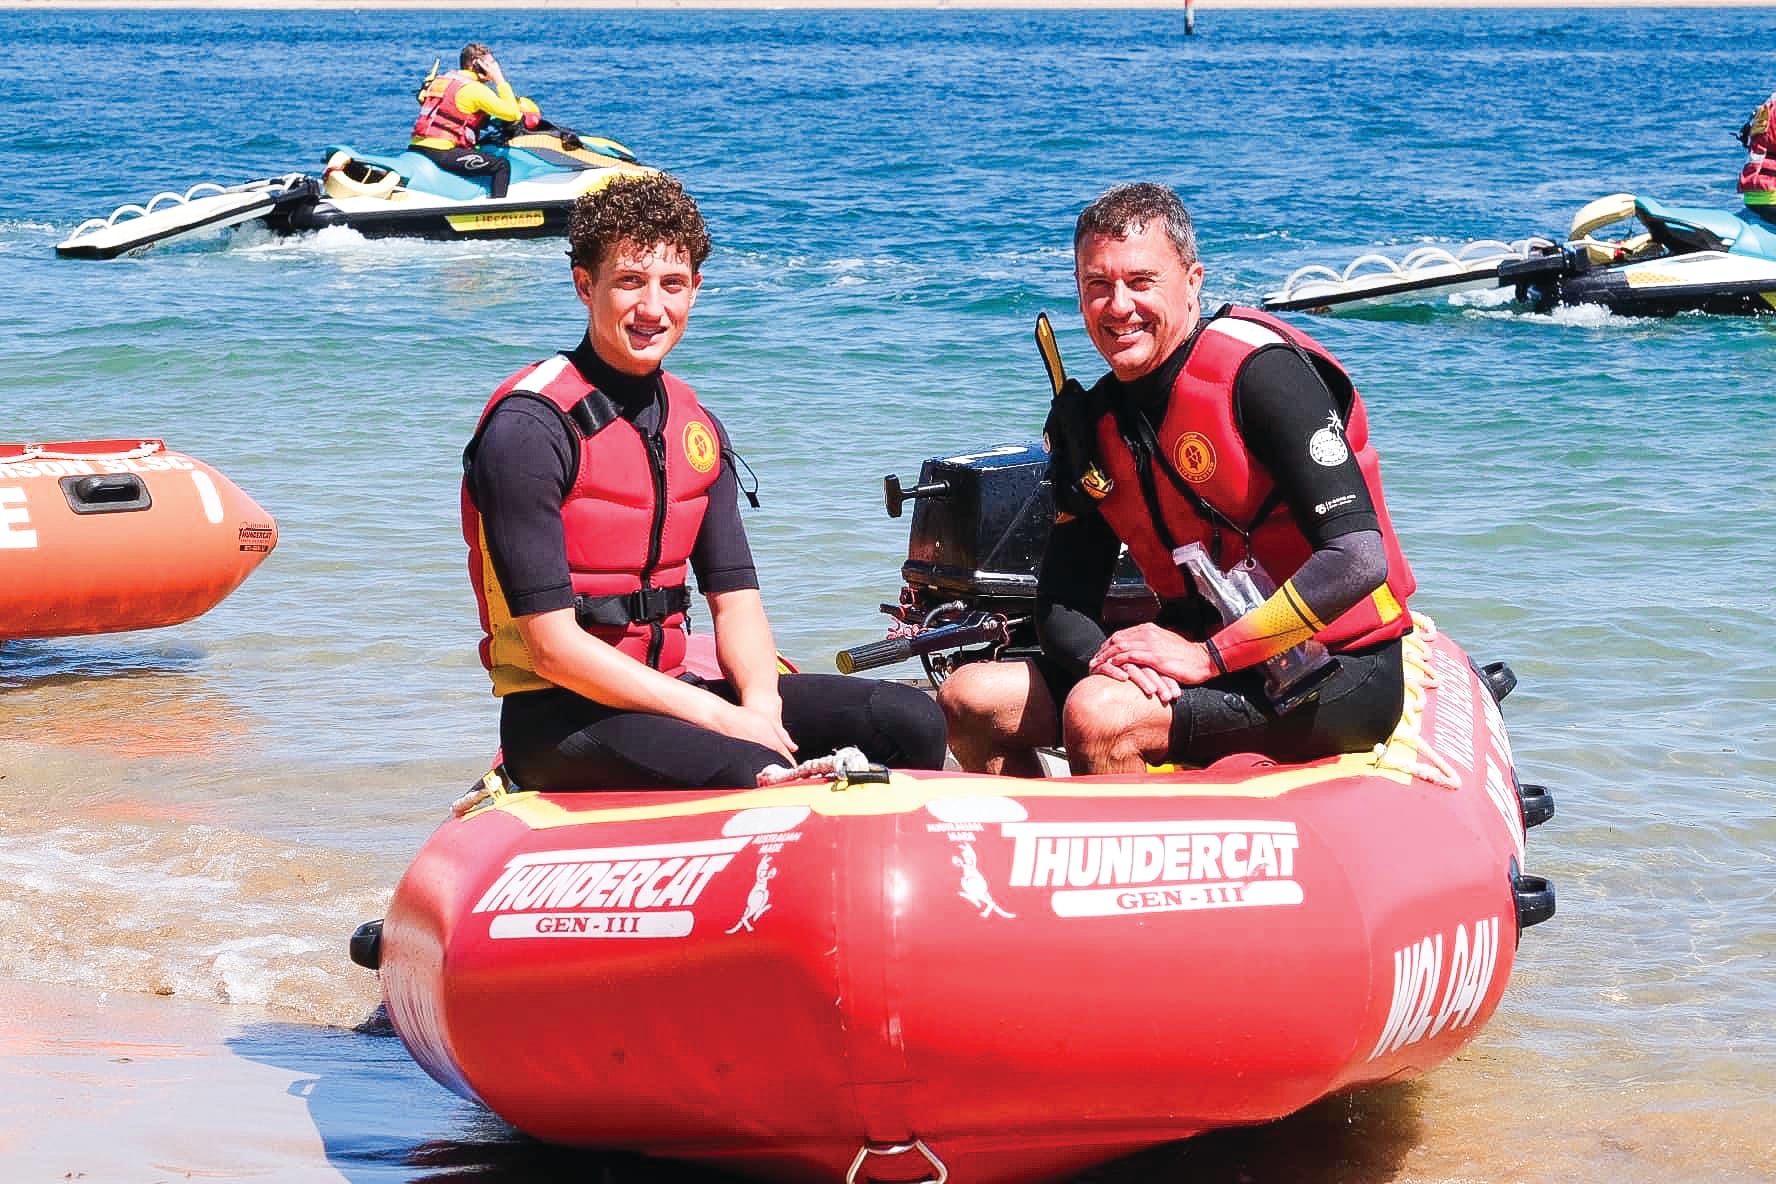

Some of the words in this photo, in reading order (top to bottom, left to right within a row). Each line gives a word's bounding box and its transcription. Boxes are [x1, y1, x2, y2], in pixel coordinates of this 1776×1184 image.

[100, 455, 195, 473] SLSC
[472, 836, 754, 914] THUNDERCAT
[1001, 820, 1300, 887] THUNDERCAT
